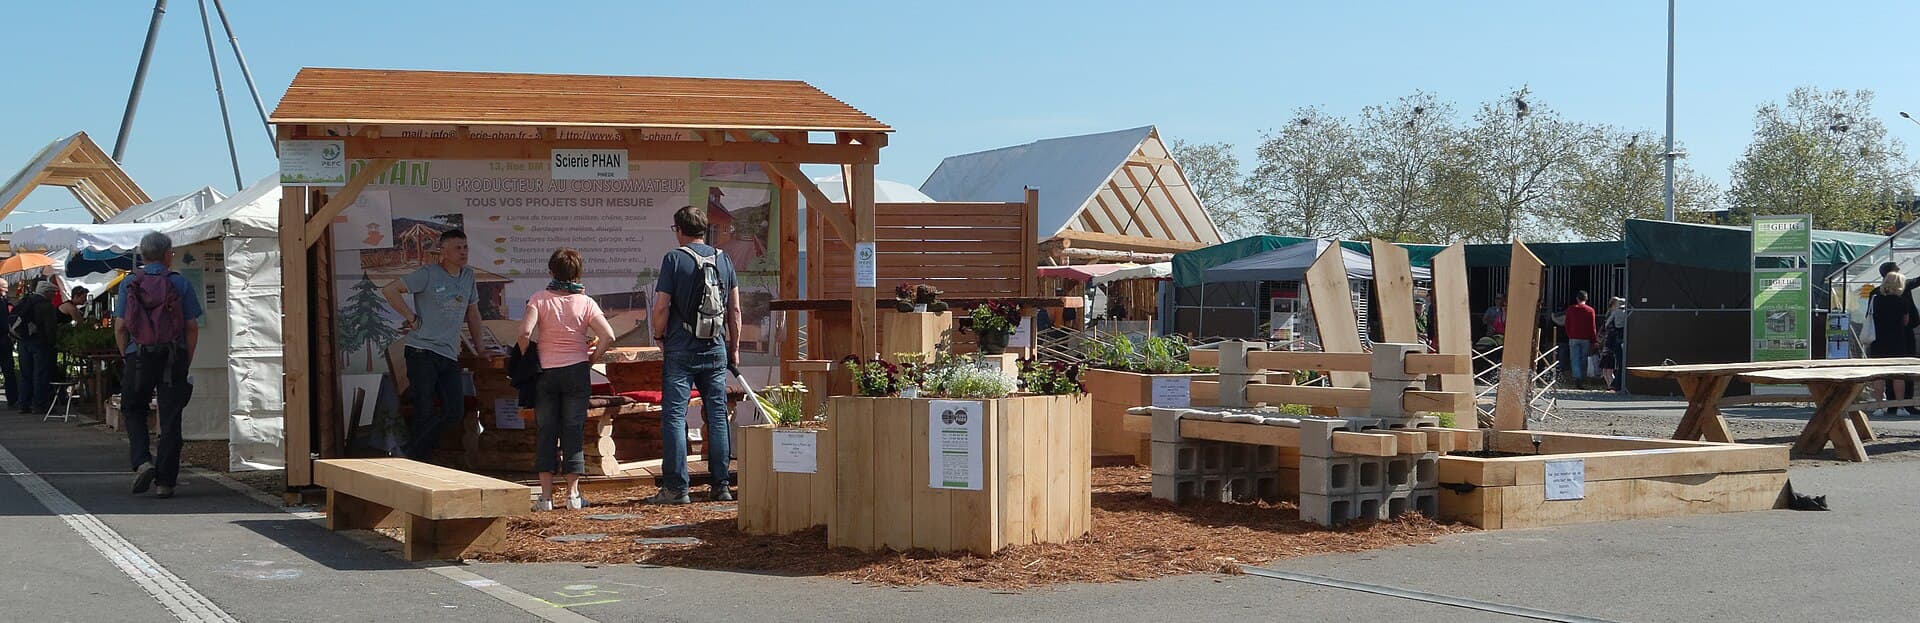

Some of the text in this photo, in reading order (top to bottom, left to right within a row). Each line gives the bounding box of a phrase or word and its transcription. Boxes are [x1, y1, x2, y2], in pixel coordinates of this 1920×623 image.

[555, 154, 589, 168] Scierie
[592, 154, 621, 168] PHAN
[350, 159, 431, 186] PAN
[432, 179, 686, 193] DU PRODUCTEUR AU CONSOMMATEUR
[465, 198, 654, 208] TOUS VOS PROJETS SUR MESURE
